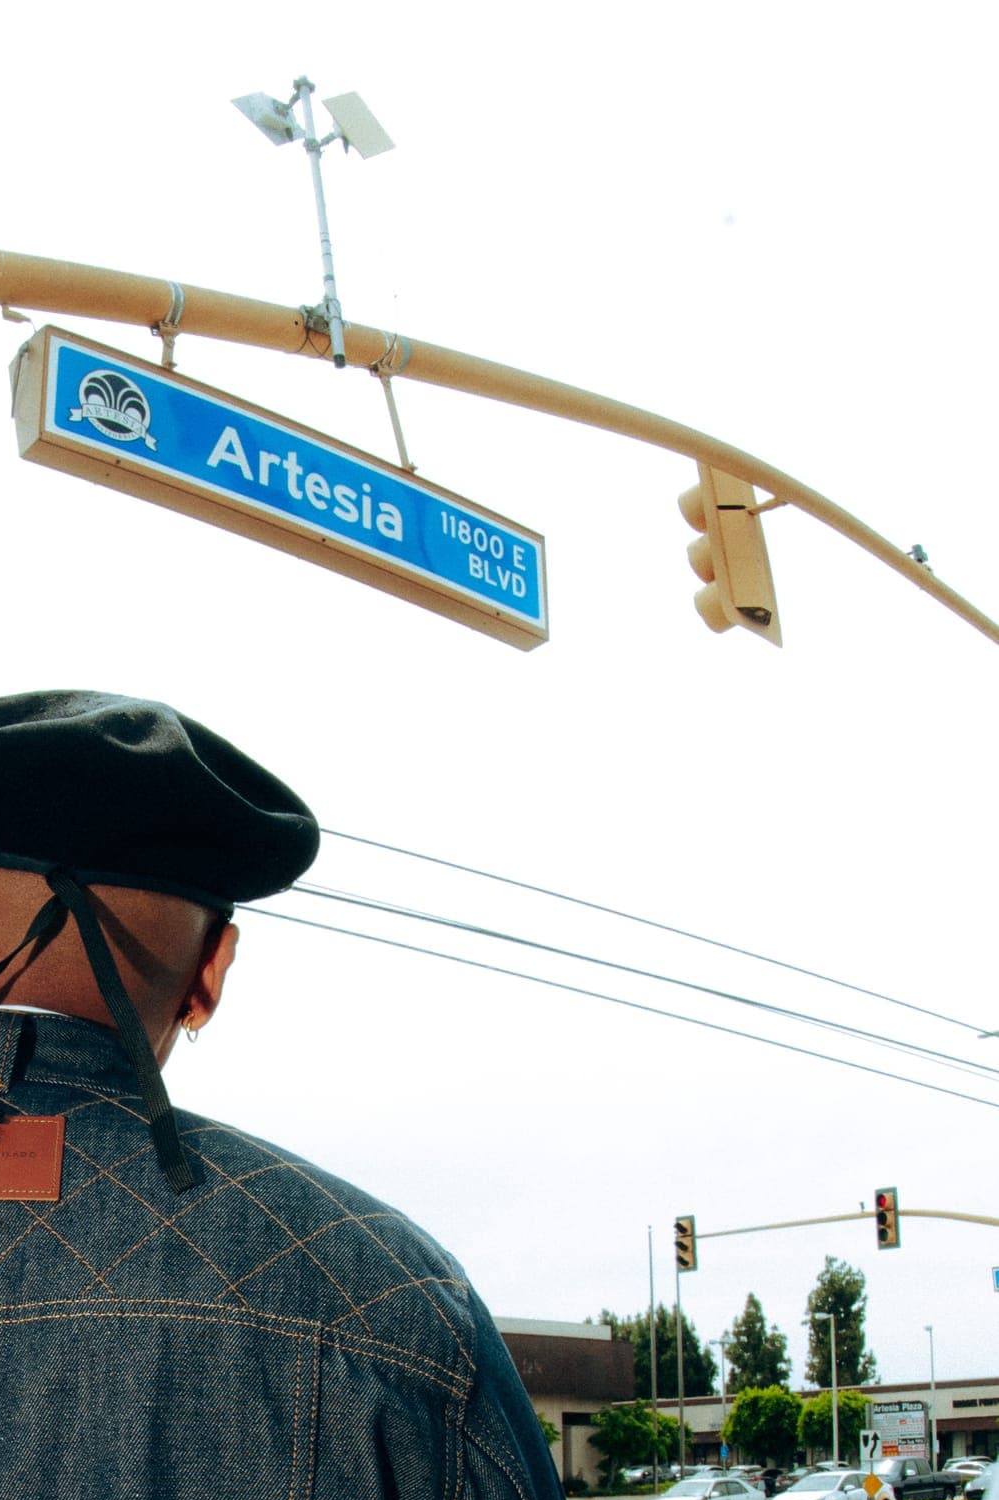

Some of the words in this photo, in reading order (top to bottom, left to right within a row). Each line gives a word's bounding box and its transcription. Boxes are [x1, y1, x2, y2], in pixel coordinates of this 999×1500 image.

[85, 406, 143, 434] ARTESIA
[207, 426, 404, 542] Artesia
[441, 511, 505, 560] 11800
[513, 544, 527, 571] E
[468, 553, 527, 598] BLVD
[873, 1404, 900, 1412] Artesia
[902, 1403, 922, 1411] Plaza
